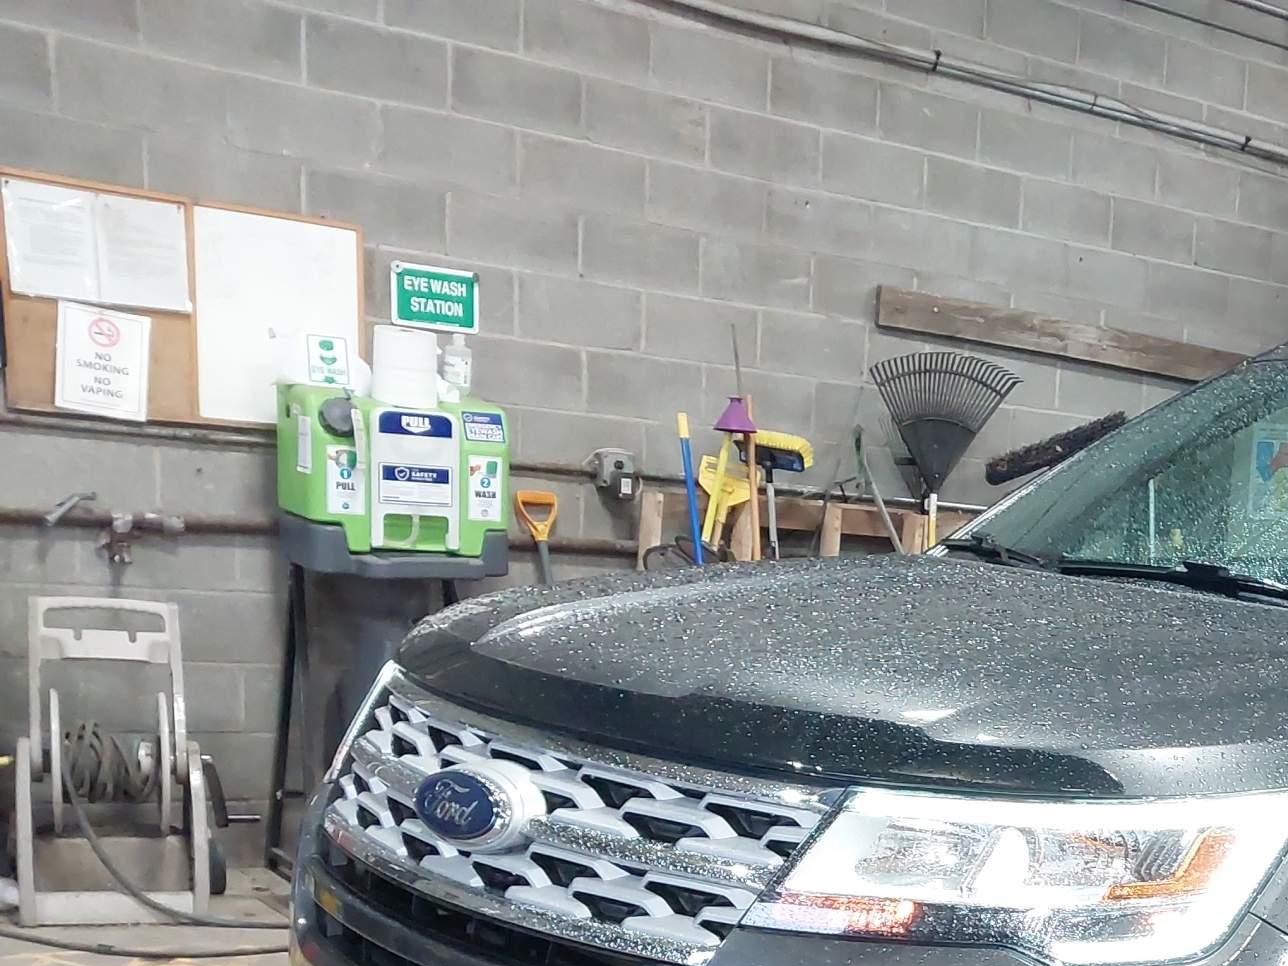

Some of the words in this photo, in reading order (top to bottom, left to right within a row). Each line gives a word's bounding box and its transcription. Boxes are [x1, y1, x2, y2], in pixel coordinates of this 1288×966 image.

[403, 275, 429, 292] EYE
[430, 279, 467, 297] WASH
[410, 297, 464, 317] STATION
[95, 352, 112, 362] NO
[75, 358, 130, 376] SMOKING
[93, 376, 111, 386] NO
[80, 384, 124, 399] VAPING
[401, 415, 431, 428] PULL
[335, 481, 356, 491] PULL
[424, 778, 479, 825] Ford
